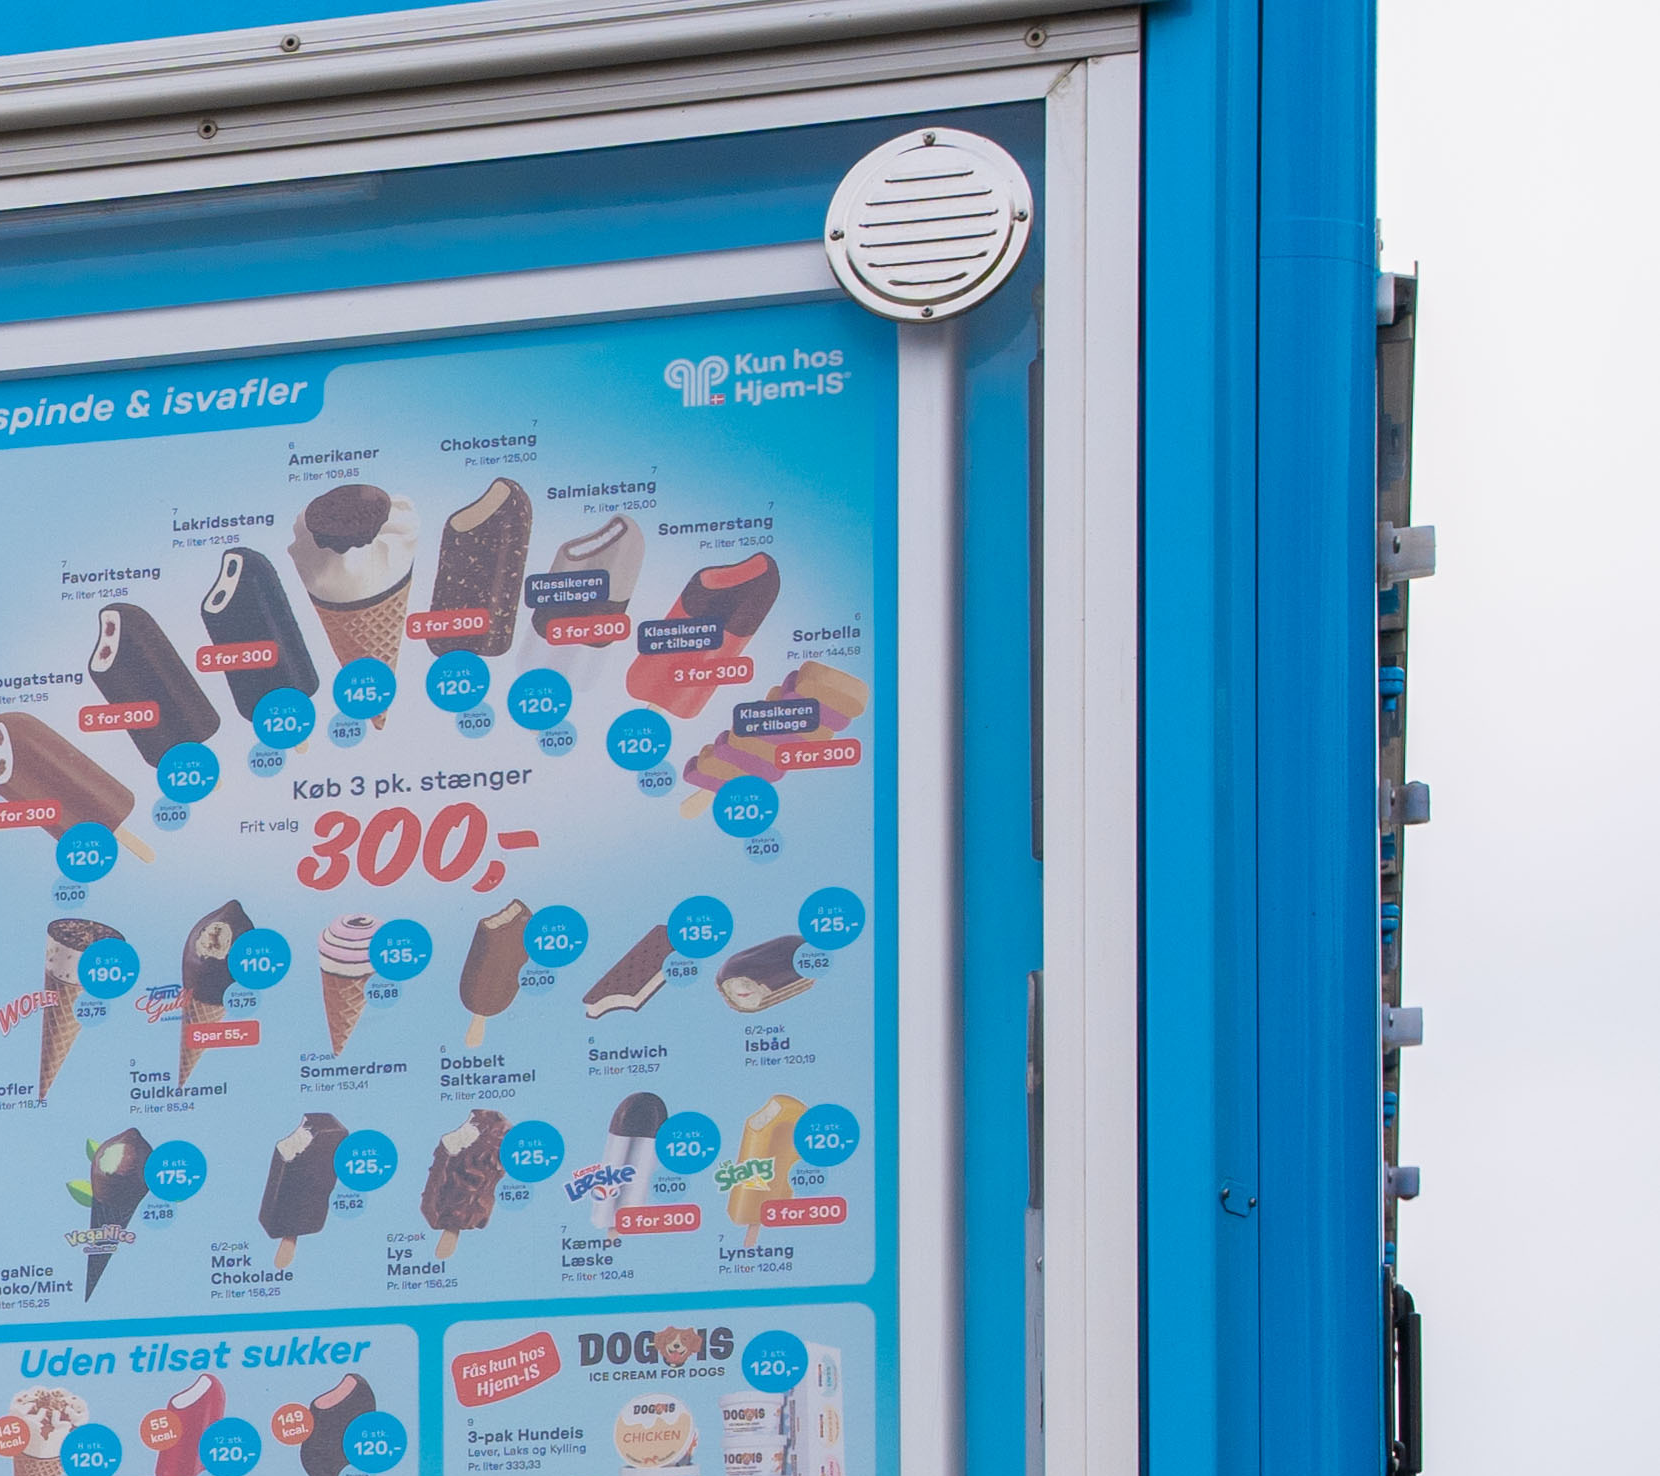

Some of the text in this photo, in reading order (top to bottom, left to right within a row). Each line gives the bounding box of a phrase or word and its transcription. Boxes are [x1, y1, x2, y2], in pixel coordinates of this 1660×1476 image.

[736, 348, 842, 374] Kun hos
[126, 390, 149, 418] &
[162, 378, 307, 415] isvafler
[441, 435, 536, 451] Chokostang
[289, 449, 379, 465] Amerikaner
[547, 482, 656, 499] Salmiakstang
[172, 511, 275, 532] Lakridsstang
[658, 516, 774, 536] Sommerstang
[61, 564, 161, 585] Favoritstang
[530, 575, 604, 592] Klassikeren
[536, 587, 598, 604] er tilbage
[413, 617, 483, 633] 3 for 300
[793, 626, 860, 642] Sorbella
[294, 769, 532, 800] Køb 3 pk. stænger
[297, 802, 539, 892] 300,-
[589, 1045, 667, 1061] Sandwich
[746, 1037, 789, 1052] Isbåd
[301, 1062, 407, 1078] Sommerdrøm
[720, 1246, 793, 1261] Lynstang
[21, 1336, 371, 1378] Uden tilsat sukker
[590, 1367, 725, 1382] ICE CREAM FOR DOGS
[468, 1427, 583, 1445] 3-pak Hundeis
